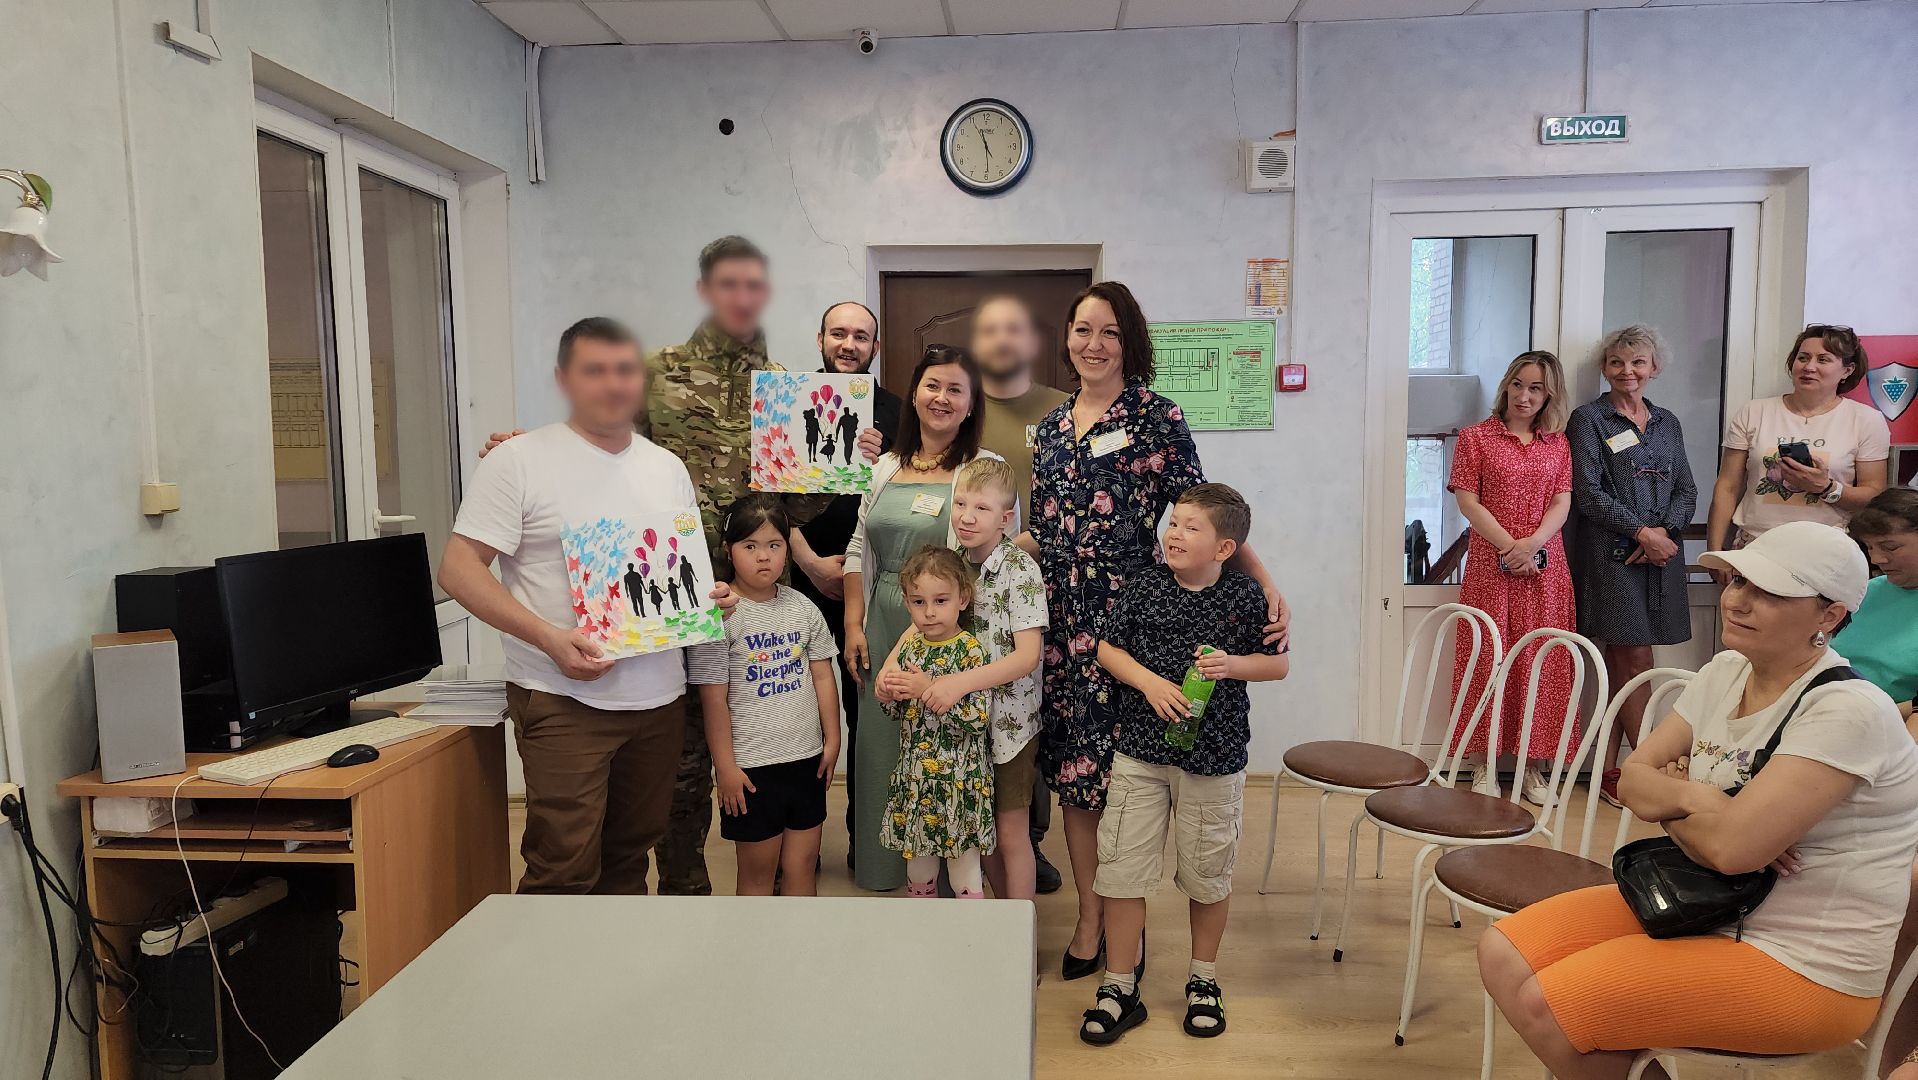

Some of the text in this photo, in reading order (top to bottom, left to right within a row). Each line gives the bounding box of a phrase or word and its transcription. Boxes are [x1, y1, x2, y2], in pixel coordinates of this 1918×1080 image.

[969, 116, 975, 124] 11
[983, 112, 991, 121] 12
[1009, 127, 1014, 136] 2
[1550, 120, 1621, 137] ВЫХОД
[956, 143, 961, 151] 9
[1012, 142, 1017, 151] 3
[960, 157, 964, 166] 8
[998, 169, 1004, 177] 5
[744, 630, 801, 650] Wake up
[772, 648, 791, 660] the
[746, 657, 804, 681] Sleeping
[757, 678, 802, 697] Closet
